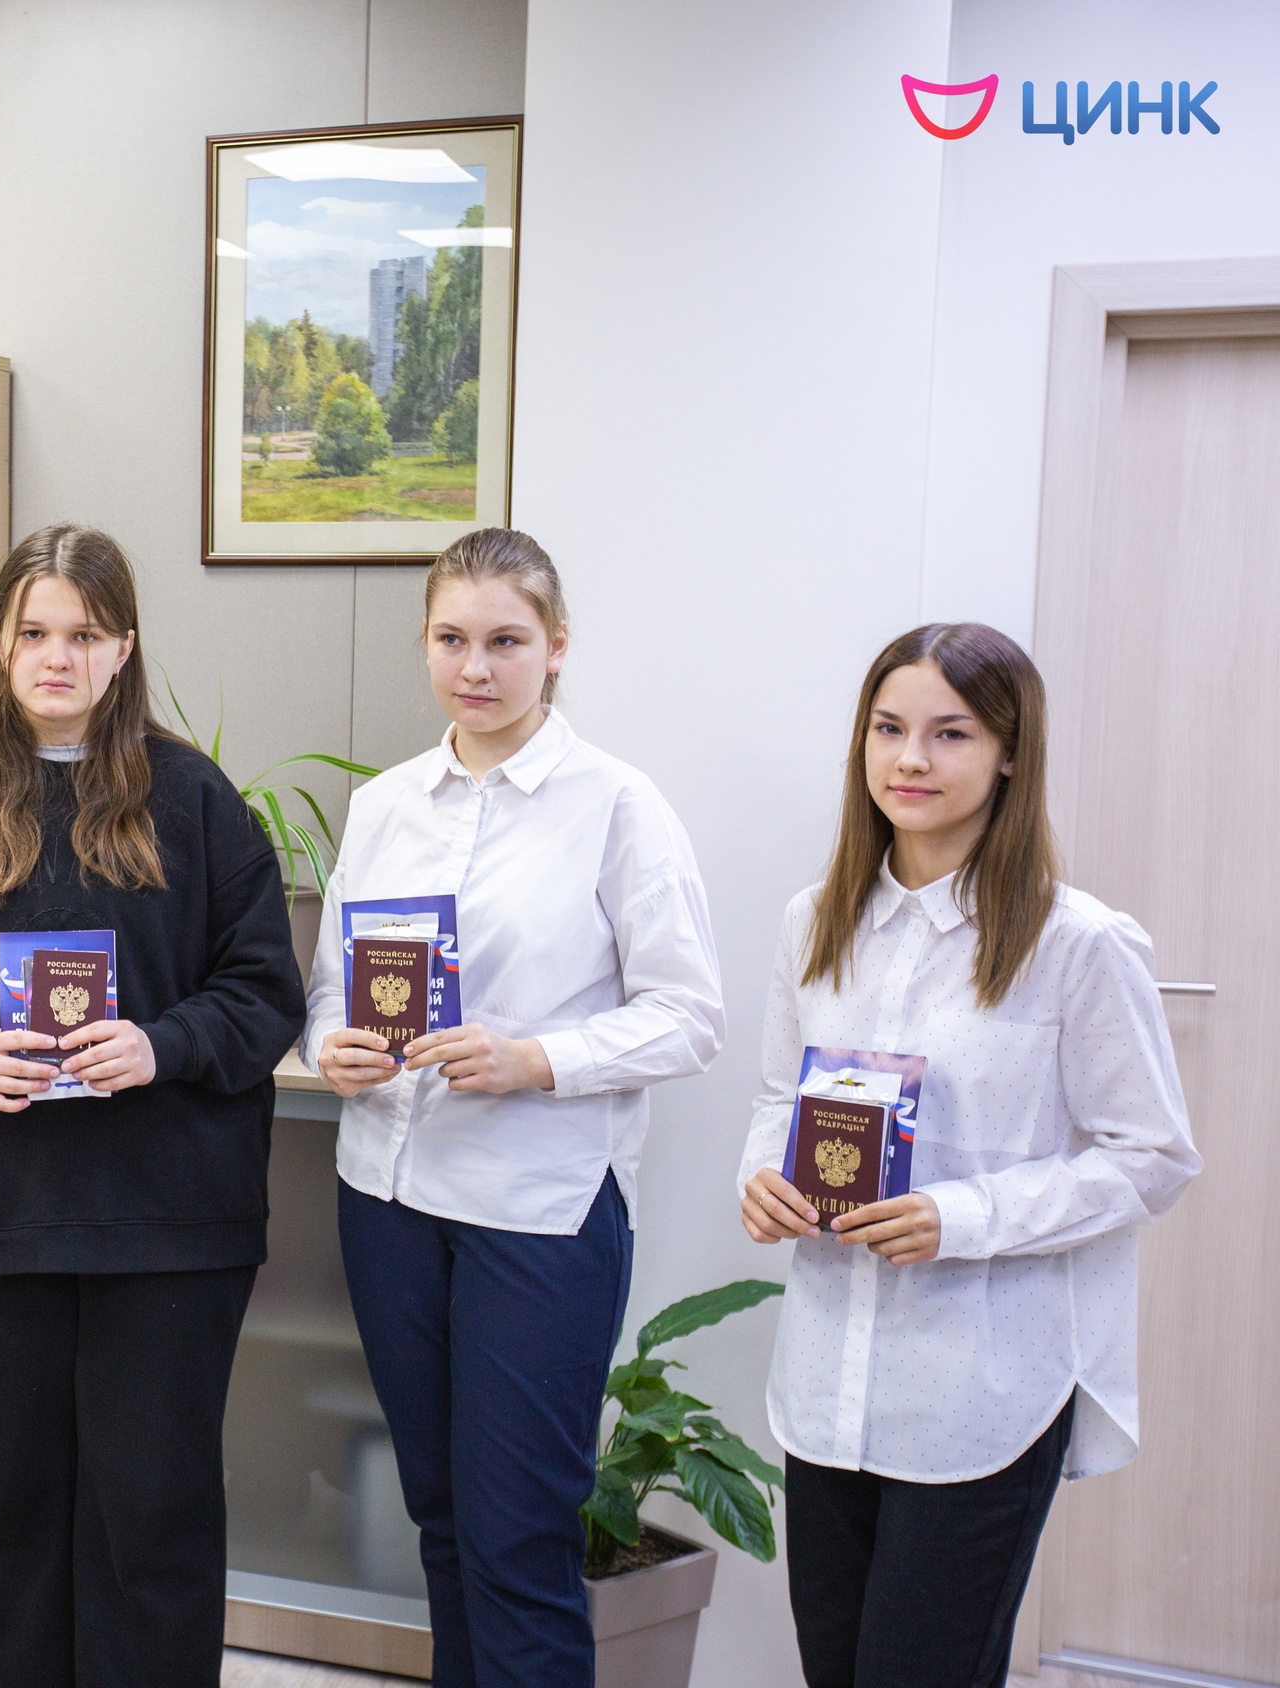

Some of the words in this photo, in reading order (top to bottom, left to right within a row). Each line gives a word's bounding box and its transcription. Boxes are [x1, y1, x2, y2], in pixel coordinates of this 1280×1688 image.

[367, 950, 417, 959] РОССИЙСКАЯ
[47, 961, 96, 970] РОССИЙСКАЯ
[370, 958, 414, 967] ФЕДЕРАЦИЯ
[49, 969, 93, 977] ФЕДЕРАЦИЯ
[813, 1109, 870, 1125] РОССИЙСКАЯ
[816, 1119, 865, 1132] ФЕДЕРАЦИЯ
